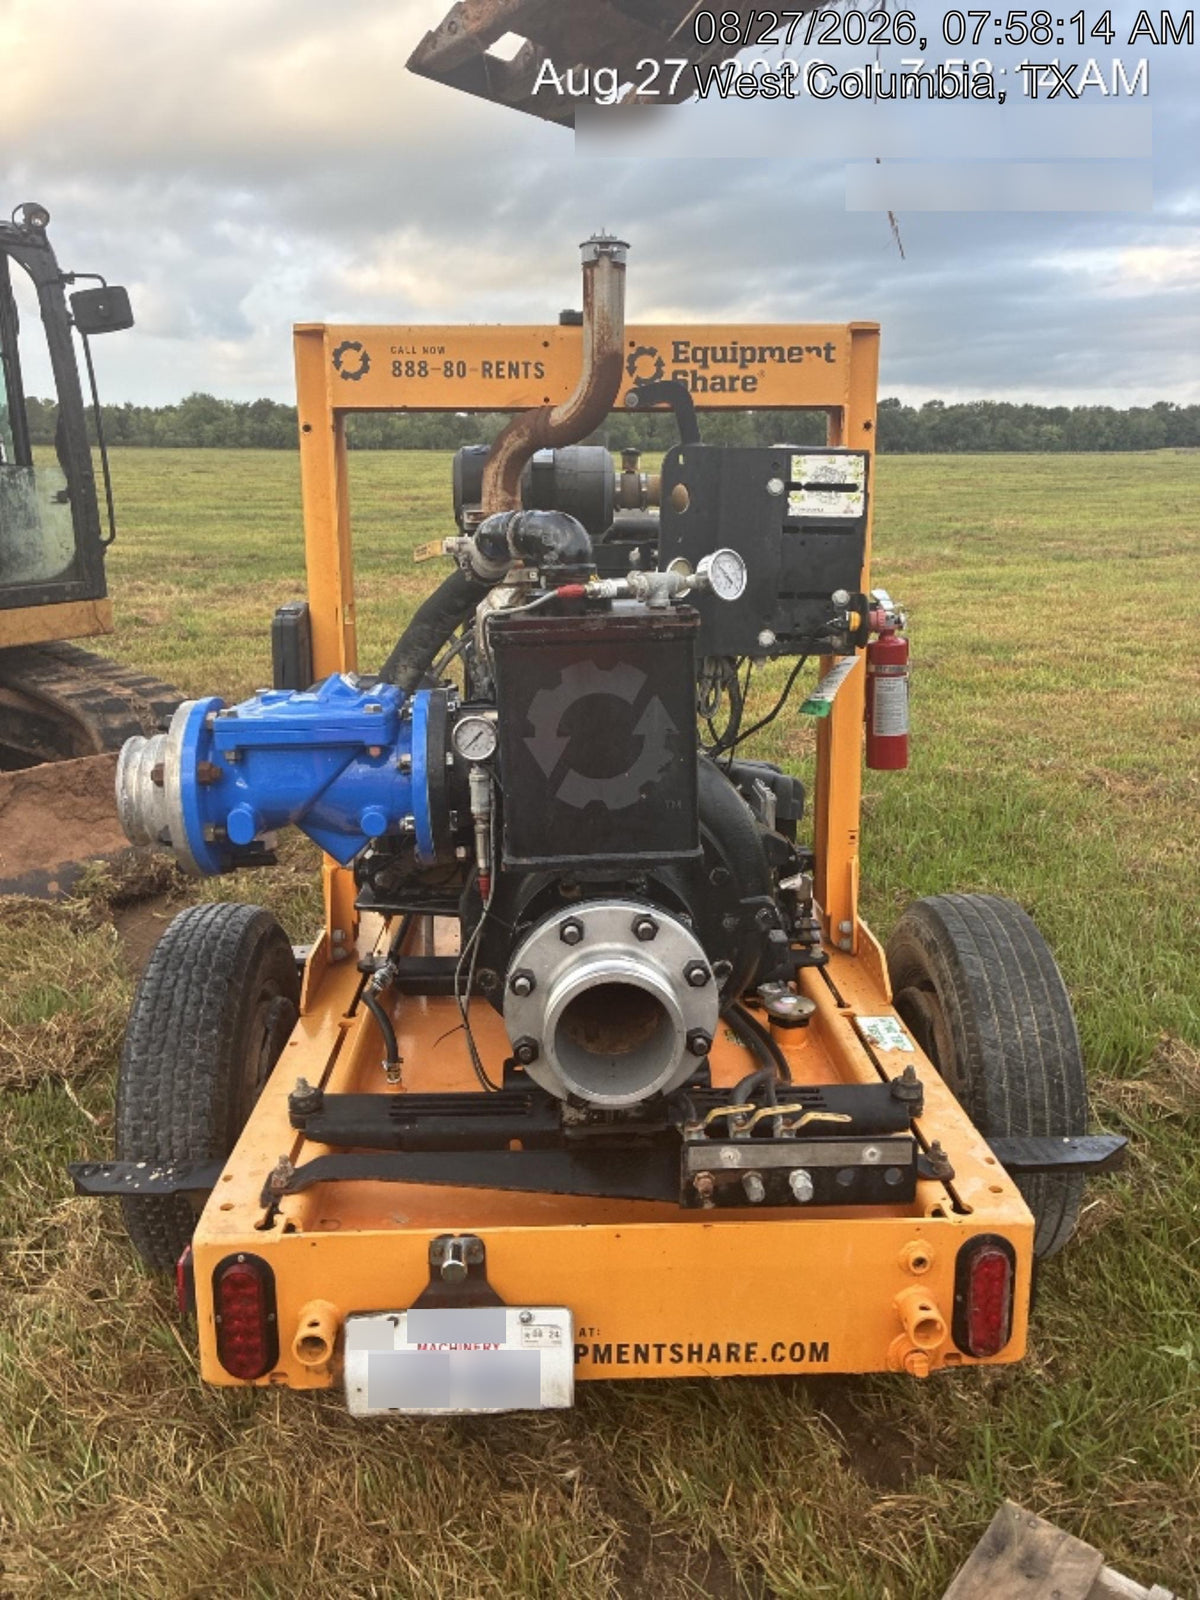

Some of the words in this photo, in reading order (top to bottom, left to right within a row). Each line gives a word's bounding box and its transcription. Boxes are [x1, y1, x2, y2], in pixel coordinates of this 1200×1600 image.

[390, 346, 417, 355] CALL
[422, 346, 446, 355] NOW
[671, 340, 836, 369] Equipment
[578, 1327, 600, 1338] AT:
